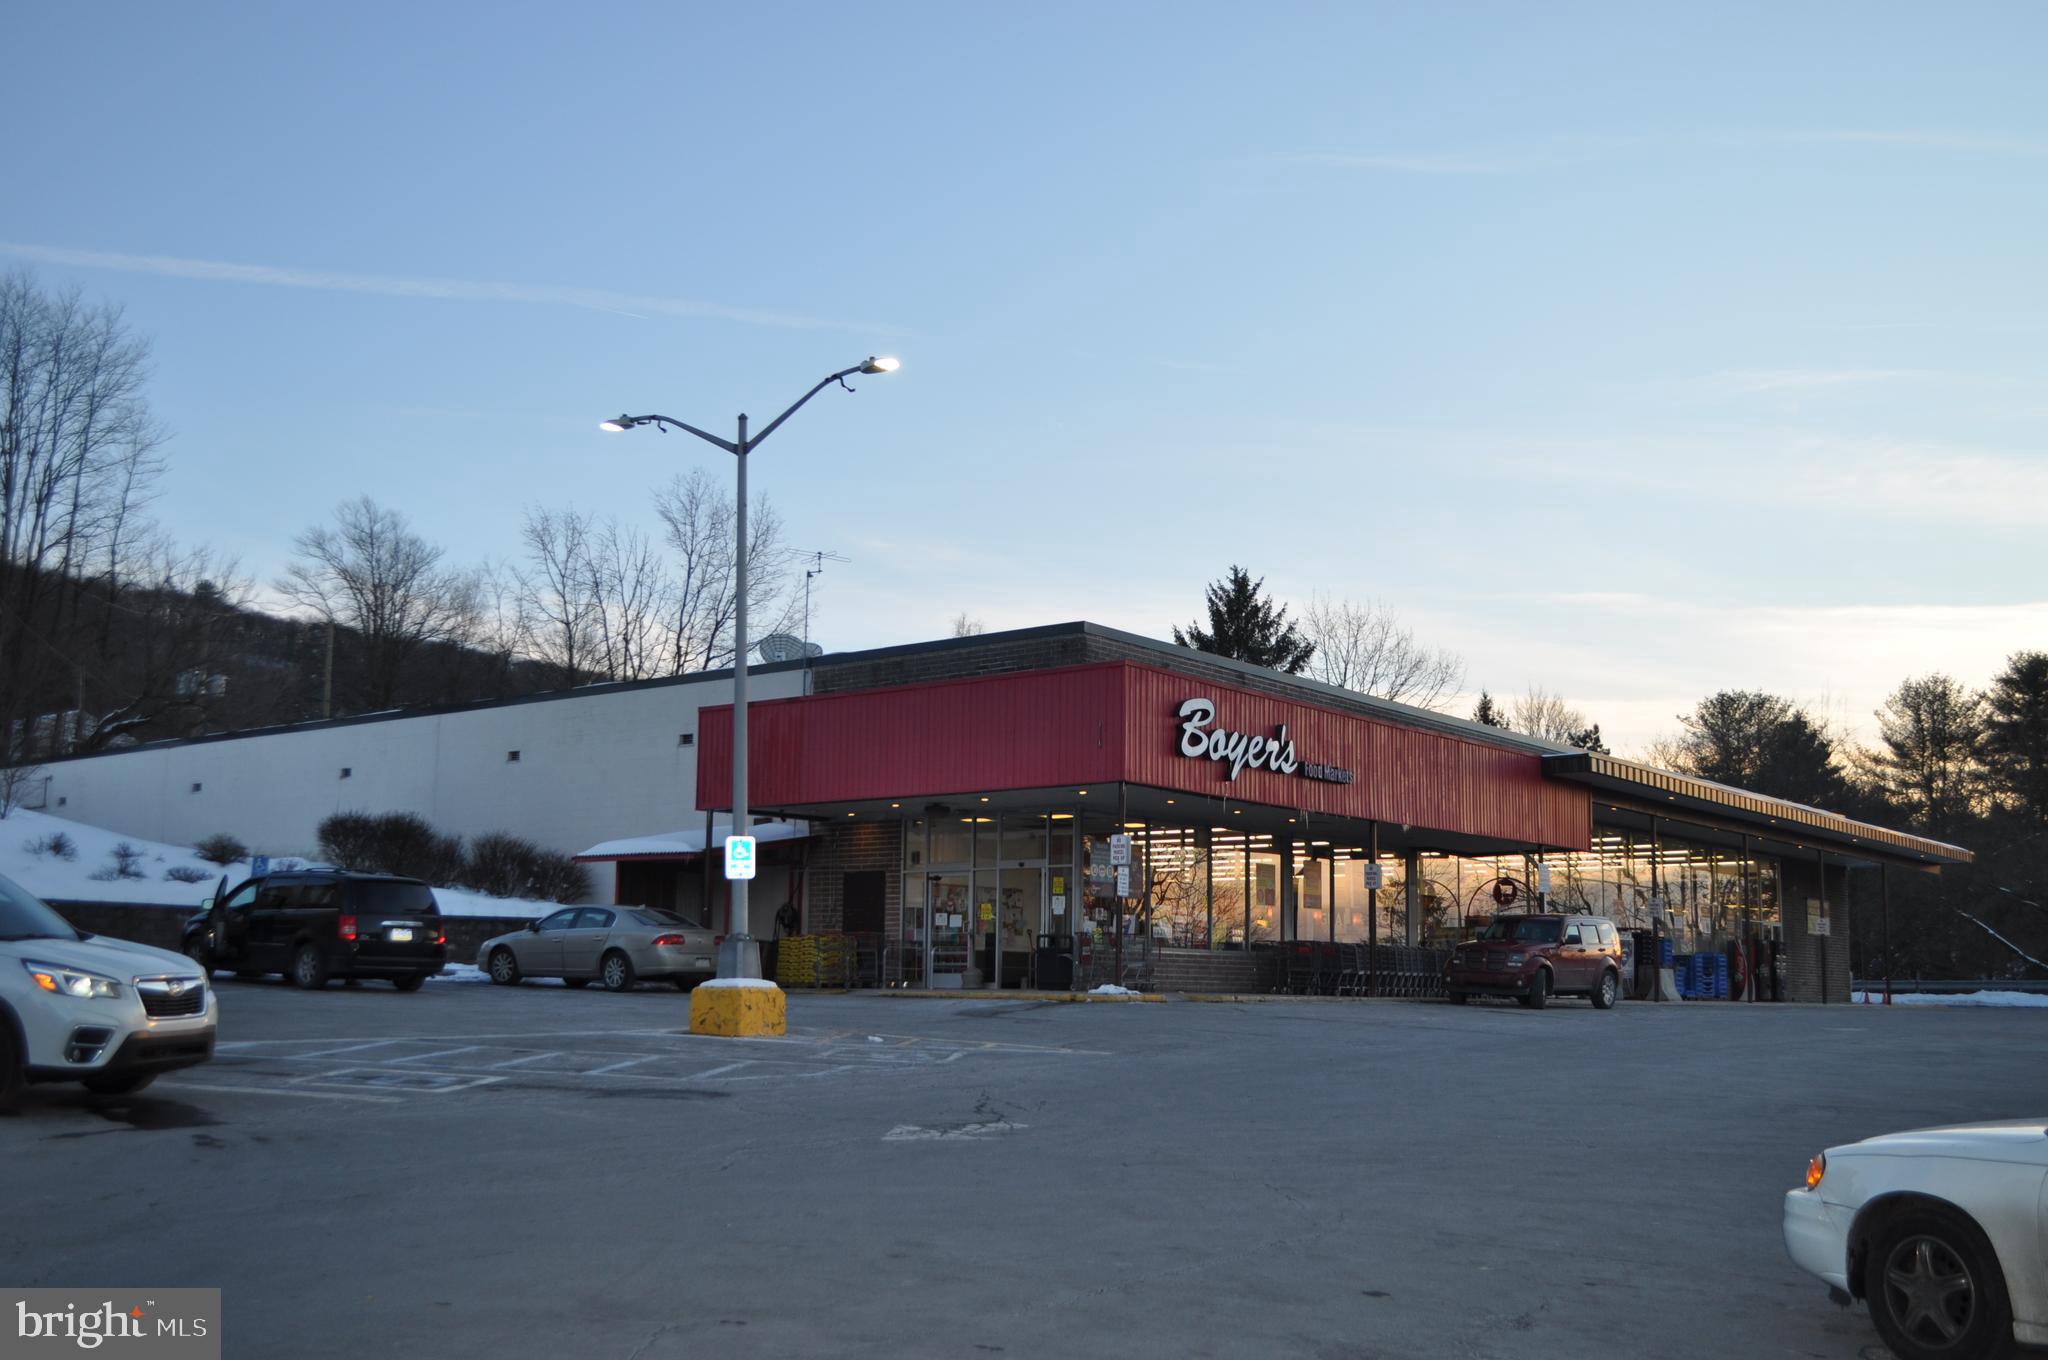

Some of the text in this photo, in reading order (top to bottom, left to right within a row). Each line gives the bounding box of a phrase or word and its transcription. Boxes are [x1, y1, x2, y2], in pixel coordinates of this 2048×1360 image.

[1178, 697, 1298, 781] Boyer's
[1304, 762, 1354, 783] Food Markets
